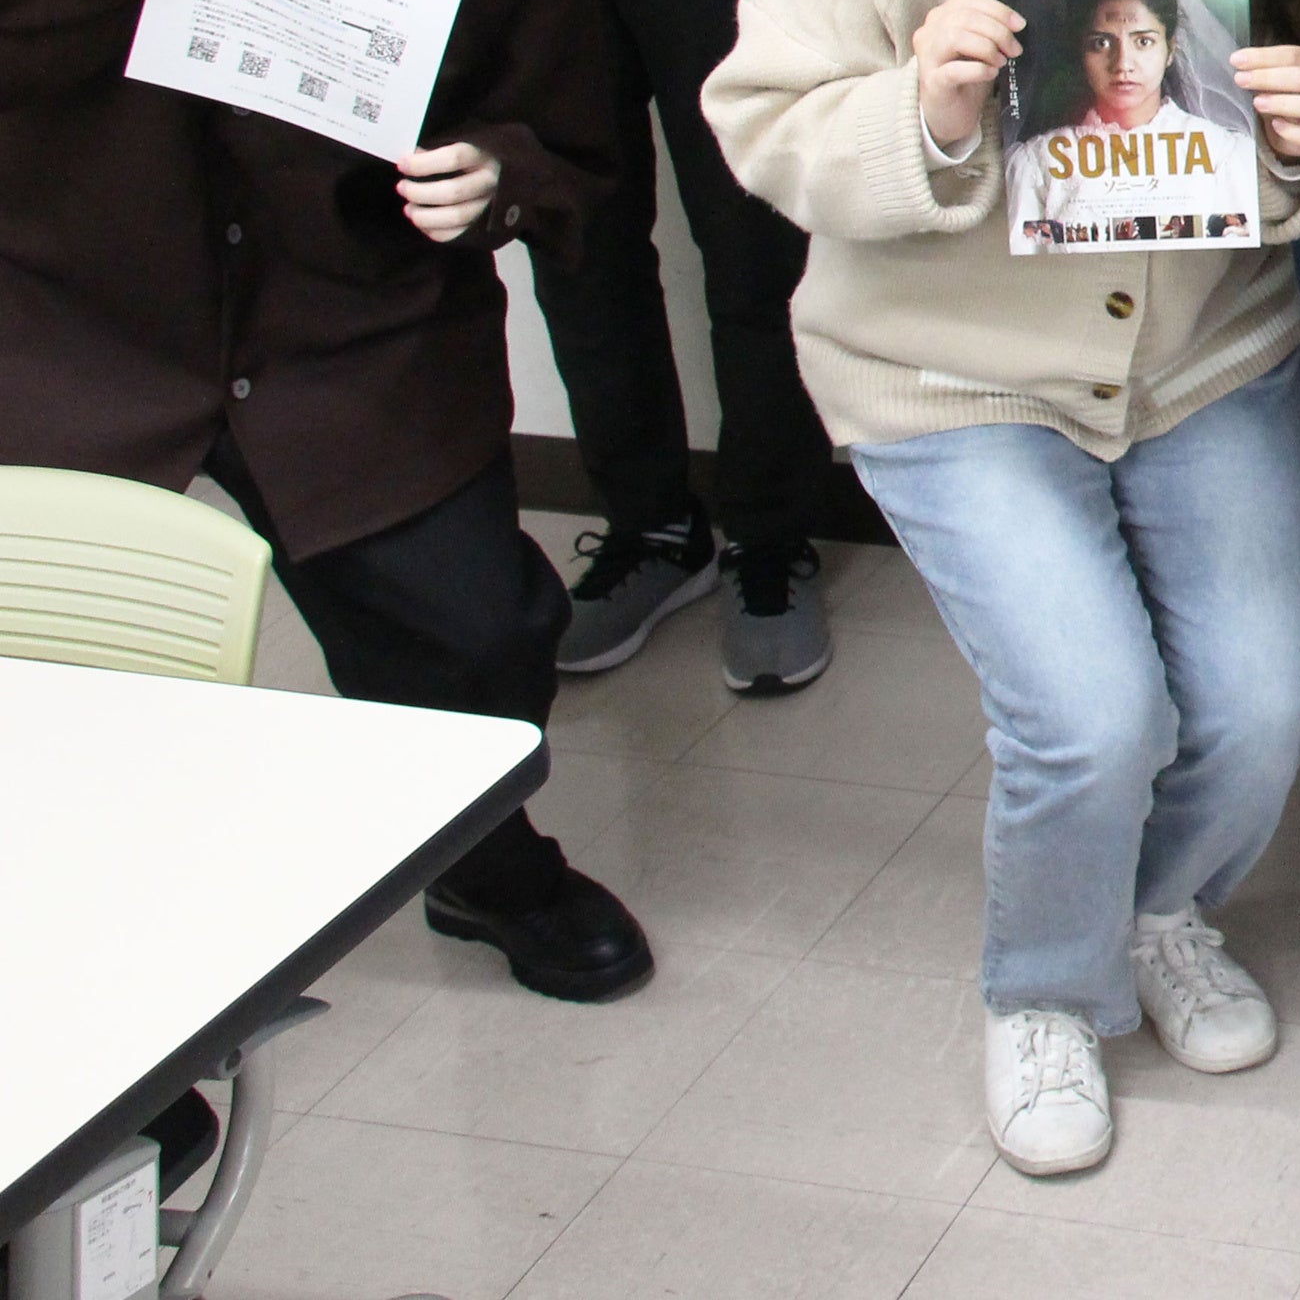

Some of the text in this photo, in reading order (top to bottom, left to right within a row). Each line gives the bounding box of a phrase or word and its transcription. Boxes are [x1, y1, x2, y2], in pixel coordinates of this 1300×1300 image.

[1048, 131, 1214, 180] SONITA
[1103, 179, 1160, 194] ソニータ
